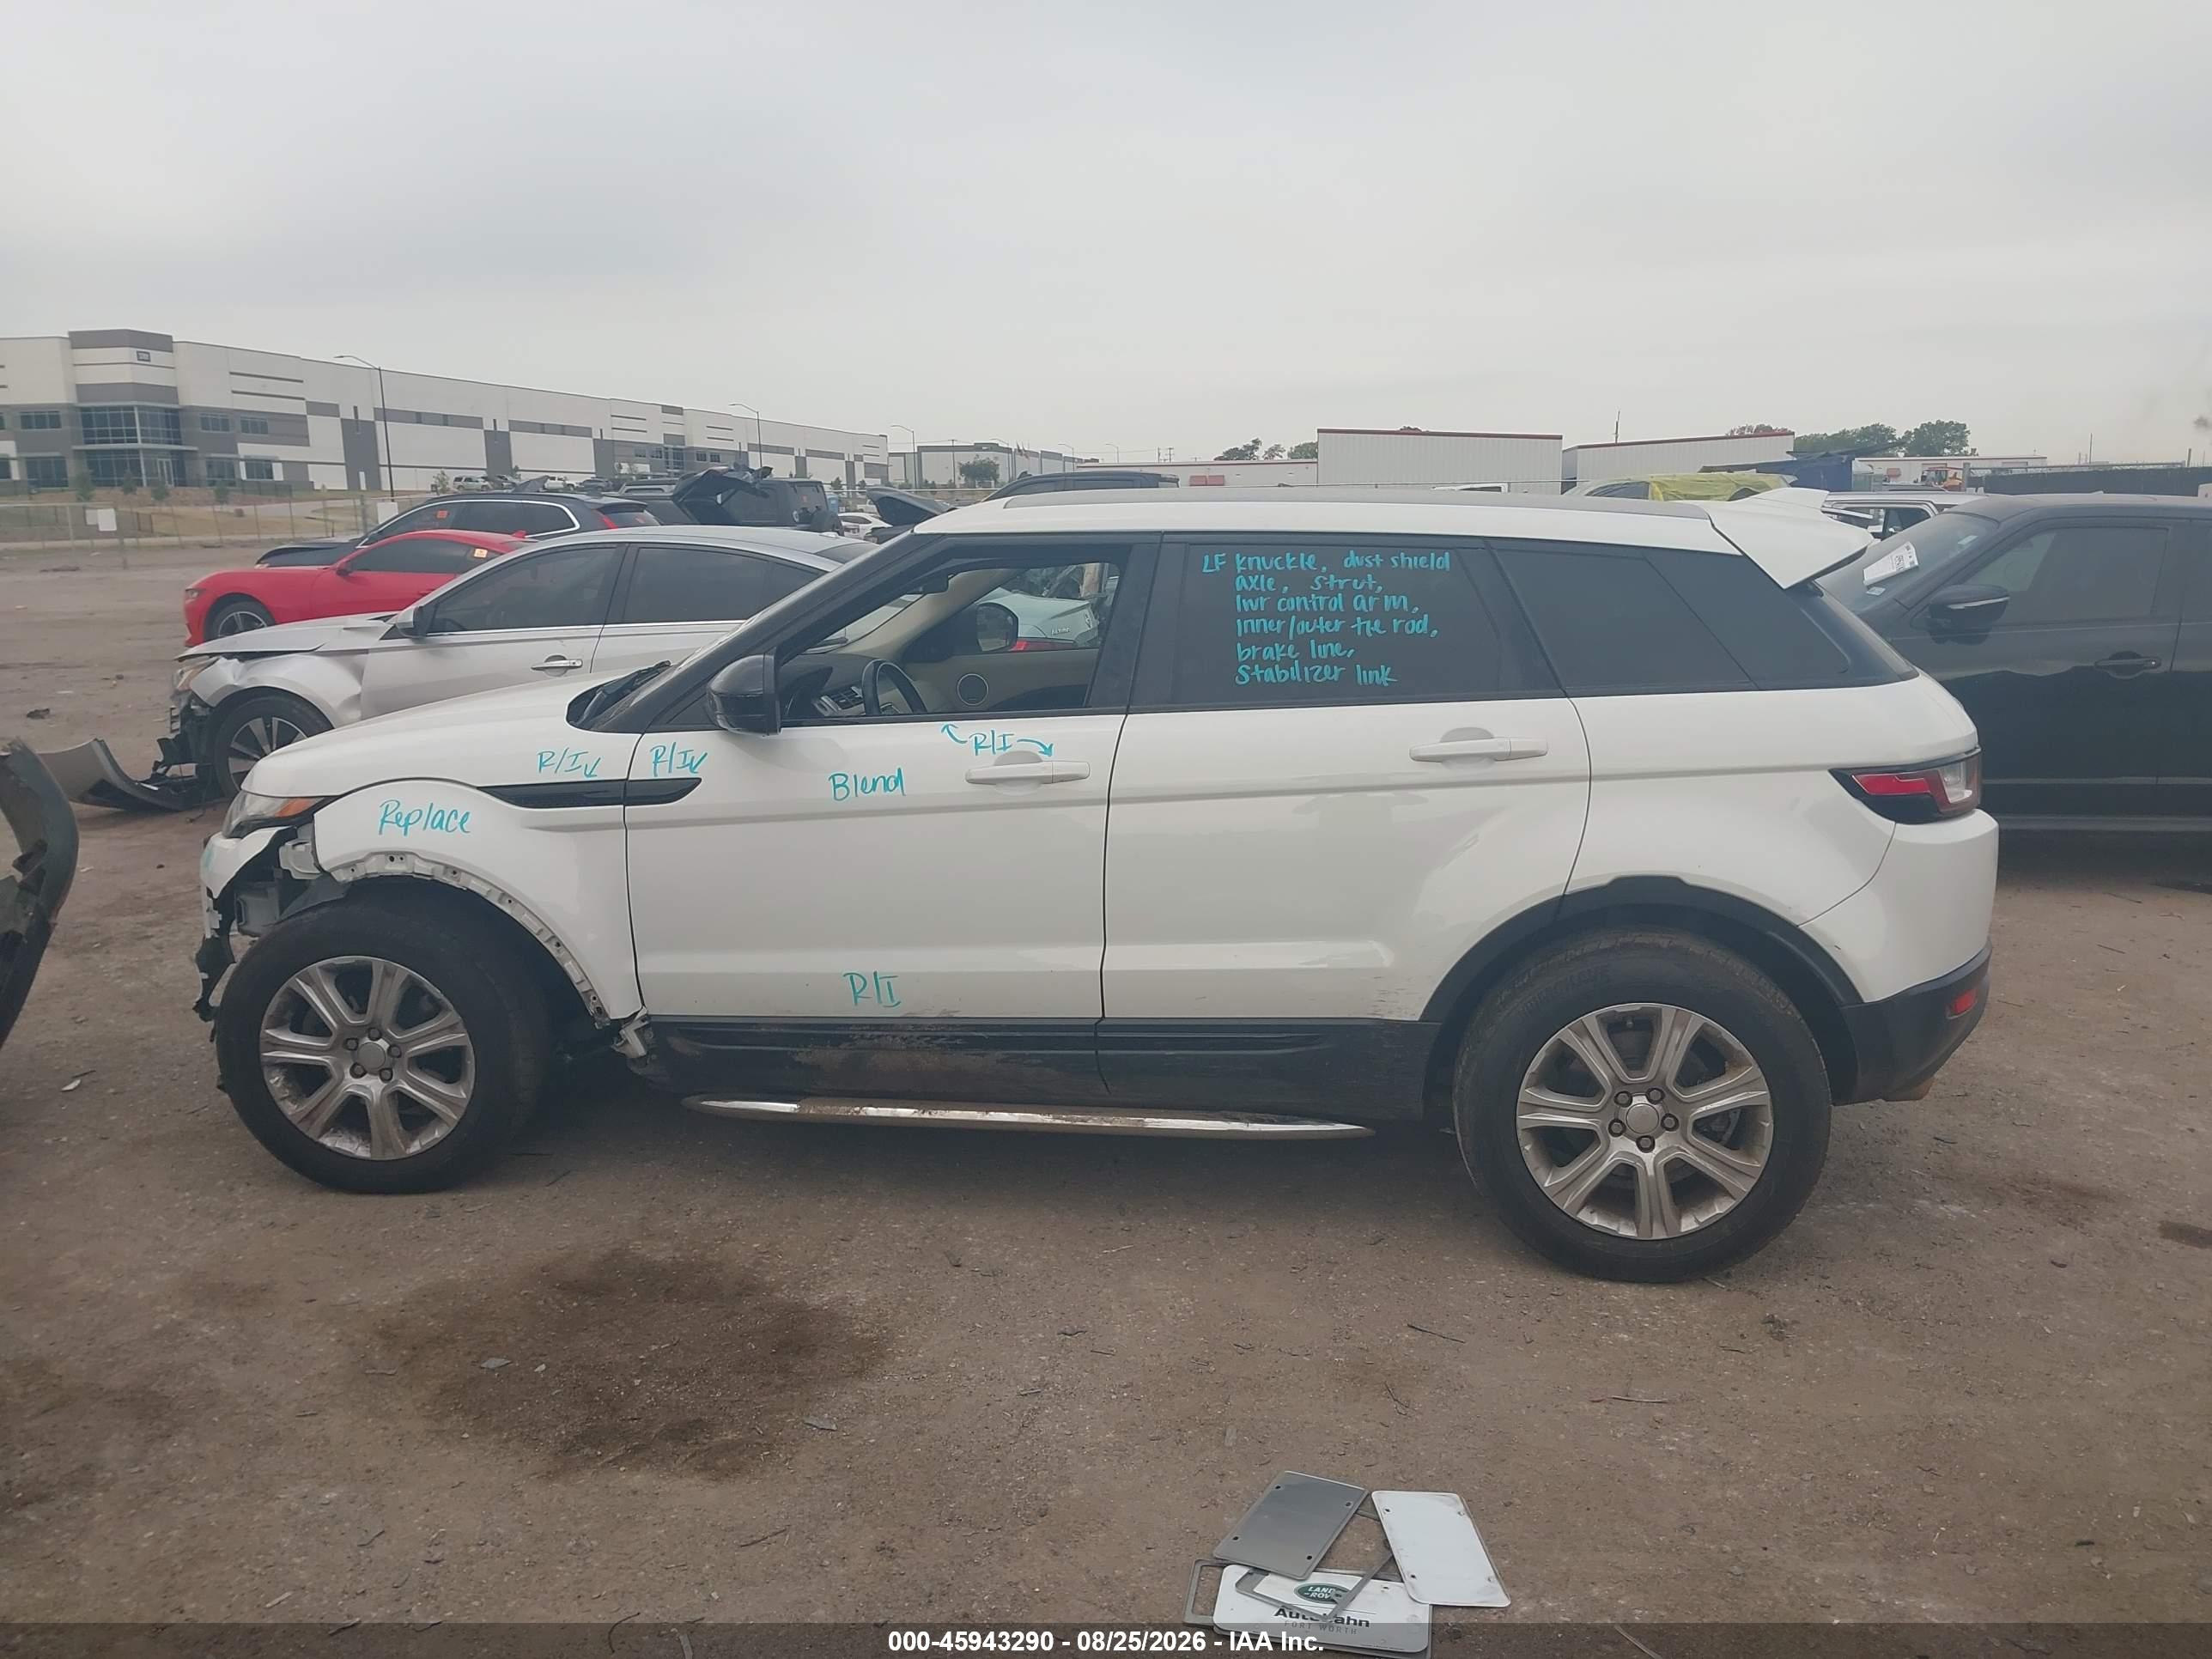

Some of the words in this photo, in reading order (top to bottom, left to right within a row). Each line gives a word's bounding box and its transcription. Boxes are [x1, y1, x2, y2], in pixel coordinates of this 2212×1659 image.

[1202, 552, 1226, 573] LF
[1343, 550, 1384, 568] dust
[1390, 551, 1450, 572] shield
[1235, 574, 1288, 594] axle,
[1277, 592, 1345, 612] control
[1393, 614, 1438, 637] rod,
[1237, 642, 1301, 662] brake
[1310, 639, 1355, 659] line,
[1356, 665, 1399, 687] link
[828, 767, 907, 802] Blend
[378, 799, 471, 837] Replace
[1274, 1607, 1370, 1628] Auahn
